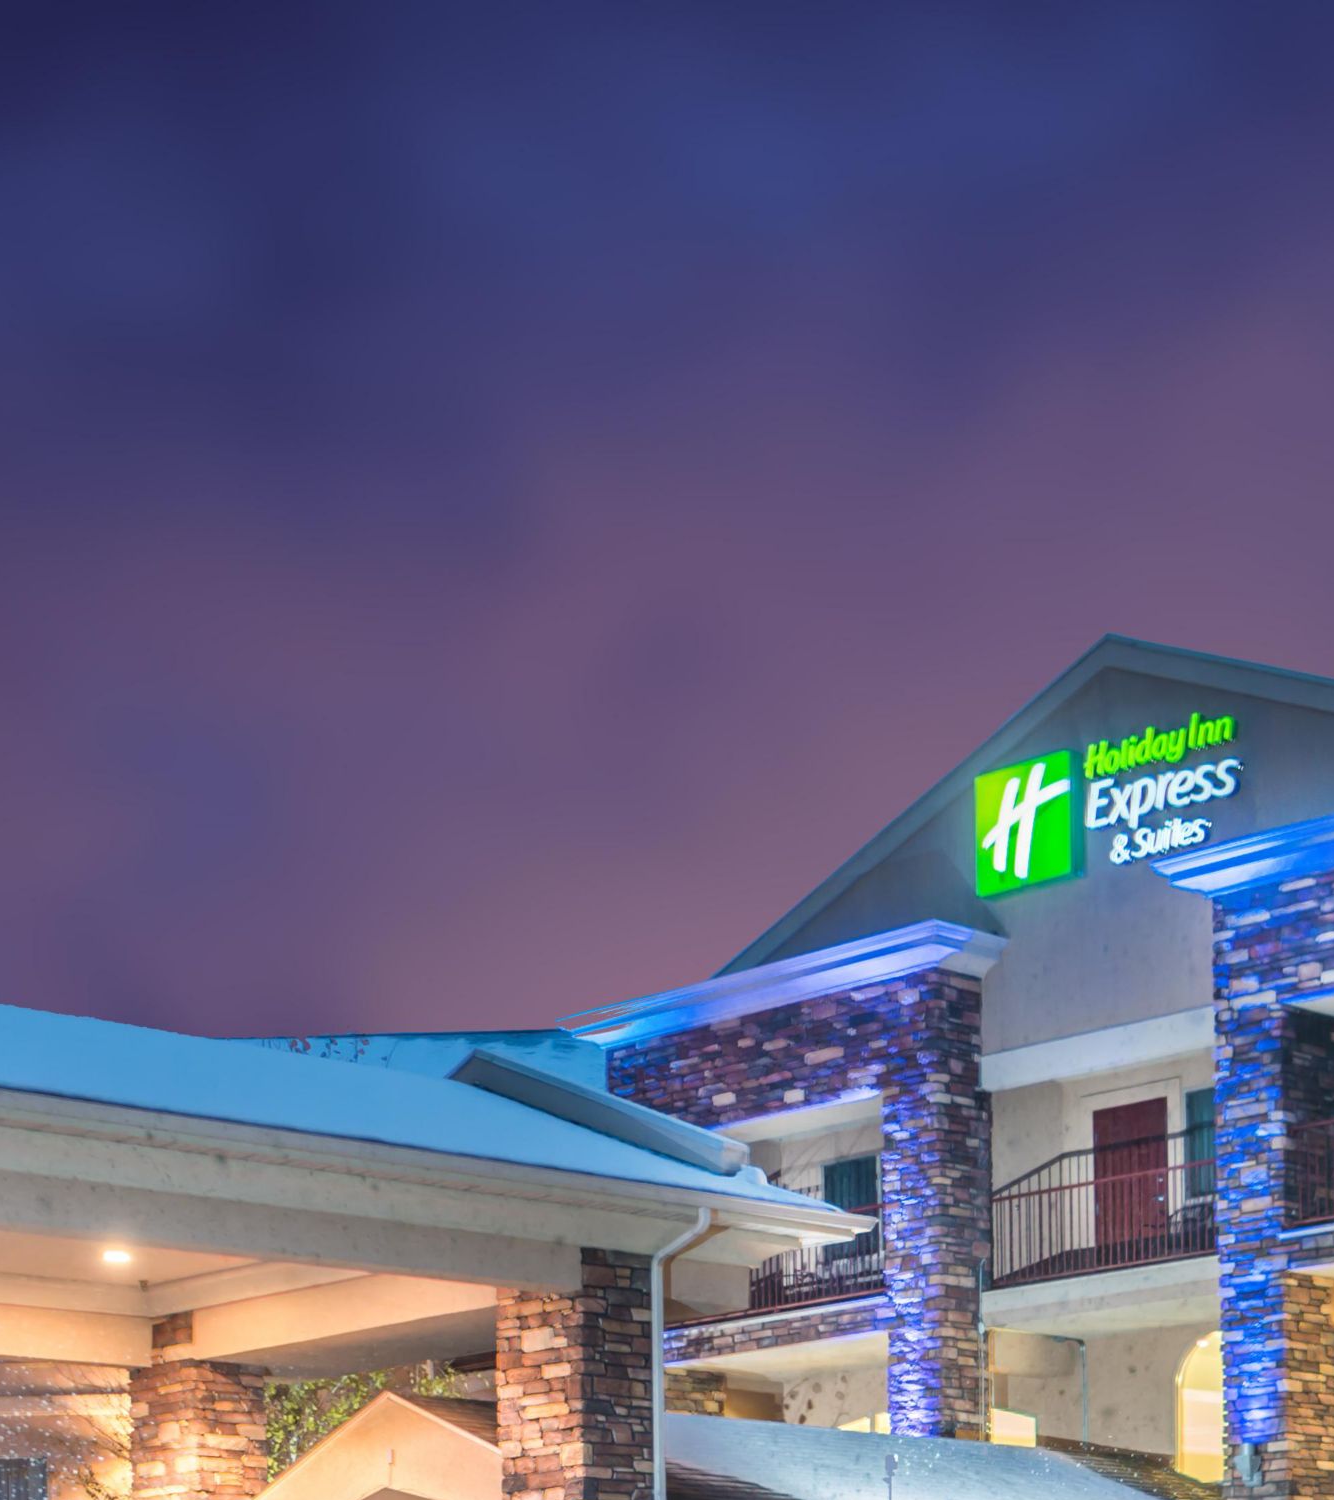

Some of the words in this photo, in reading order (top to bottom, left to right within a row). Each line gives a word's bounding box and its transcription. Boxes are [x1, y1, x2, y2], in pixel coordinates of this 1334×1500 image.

[1083, 725, 1187, 779] Holiday
[1187, 711, 1235, 749] Inn
[1085, 757, 1240, 830] Express
[1109, 833, 1131, 865] &
[1131, 816, 1207, 858] Suites
